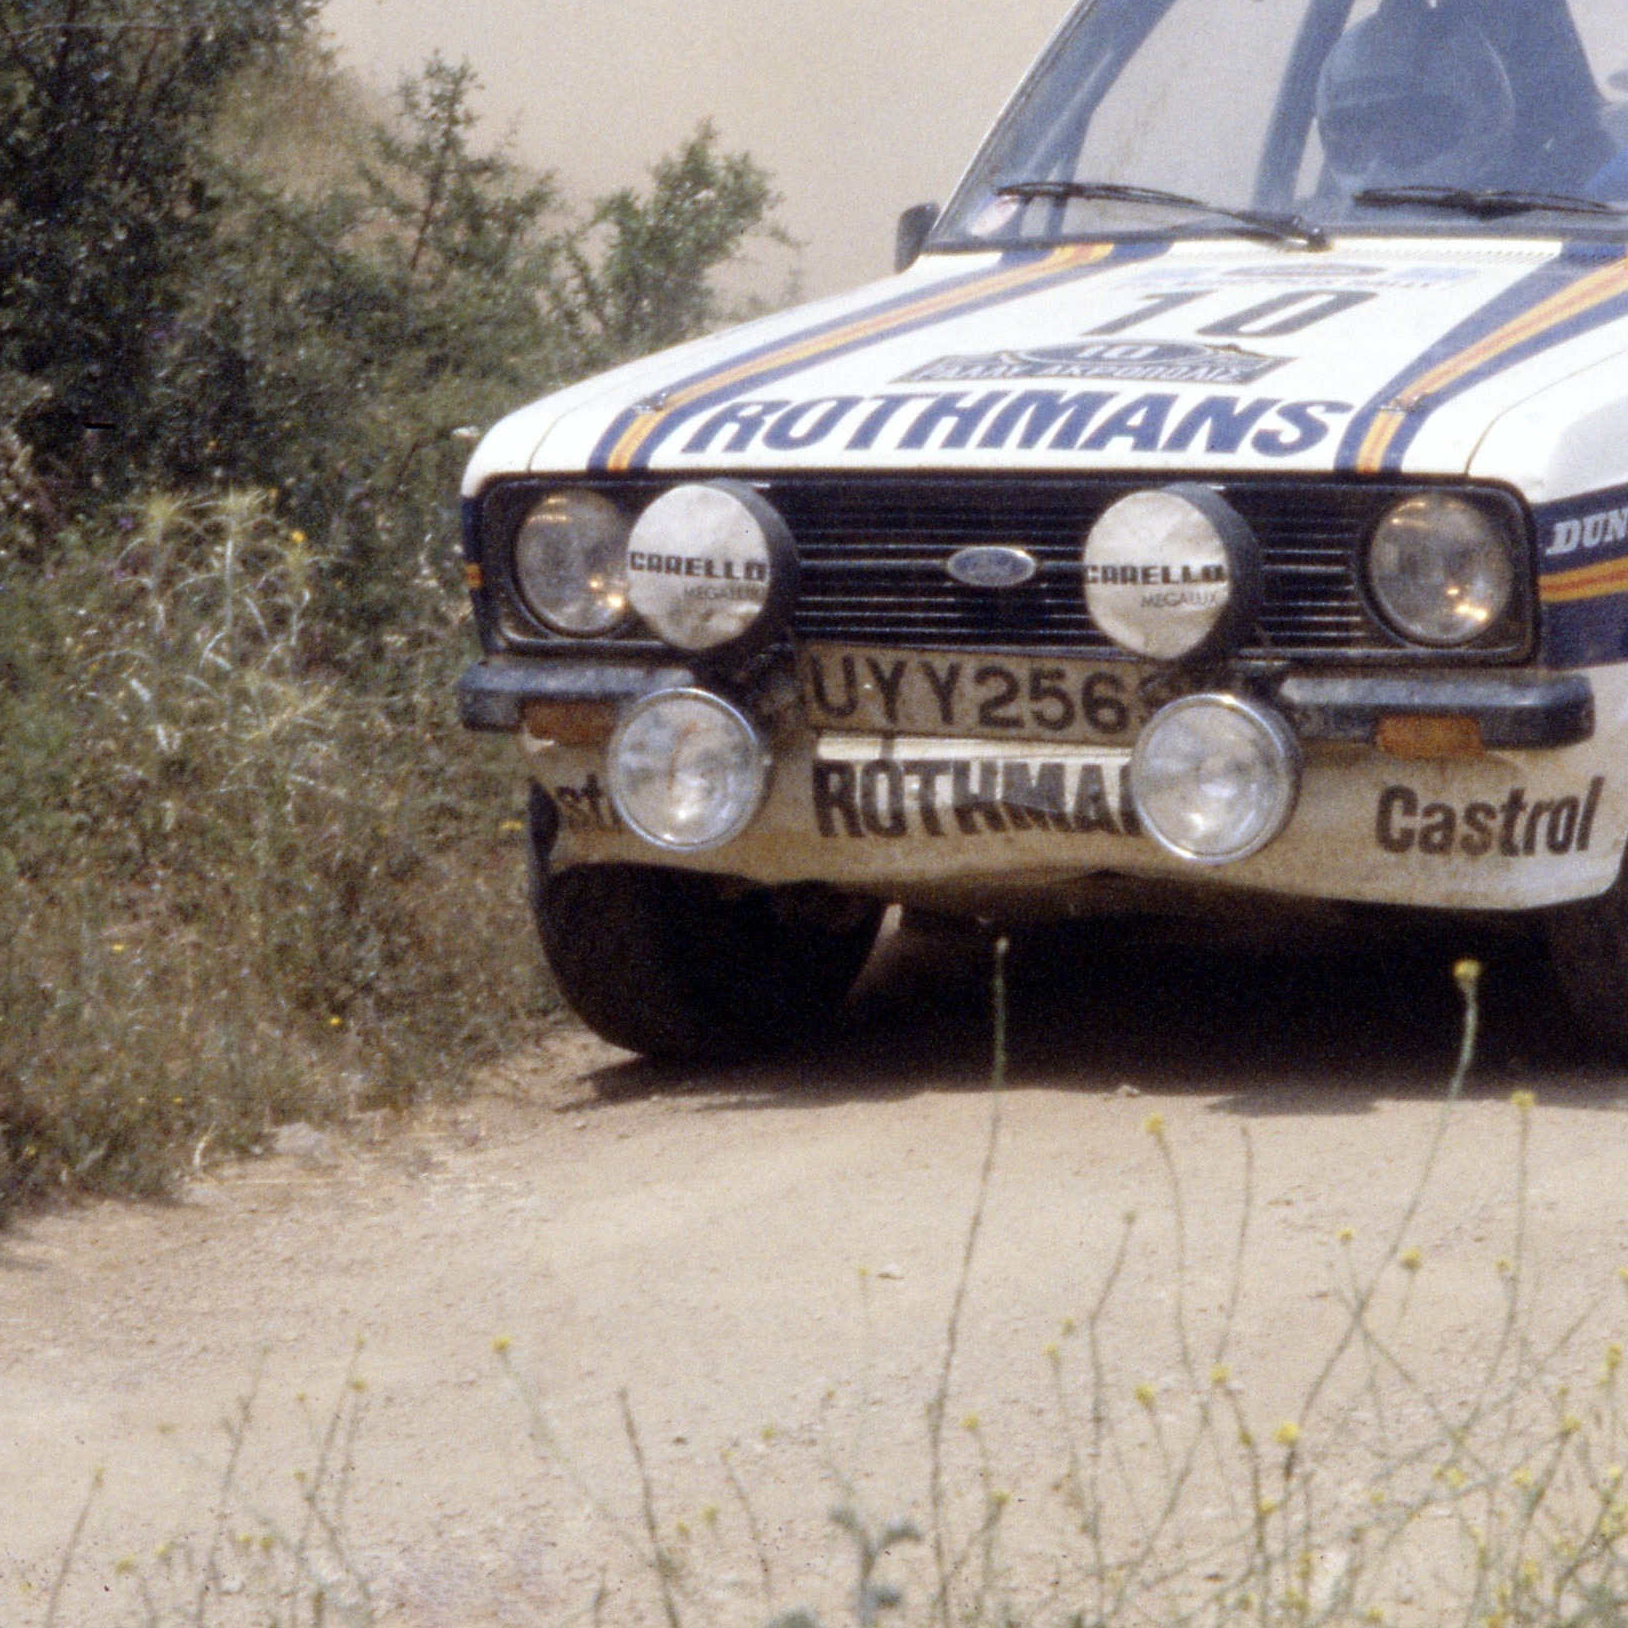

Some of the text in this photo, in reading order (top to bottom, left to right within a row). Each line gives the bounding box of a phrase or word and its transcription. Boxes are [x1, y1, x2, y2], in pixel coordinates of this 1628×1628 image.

[1077, 289, 1380, 338] 10
[680, 389, 1355, 458] ROTHMANS
[629, 551, 768, 582] CARELLO
[1084, 563, 1227, 585] CARELLO
[1375, 774, 1606, 857] Castrol
